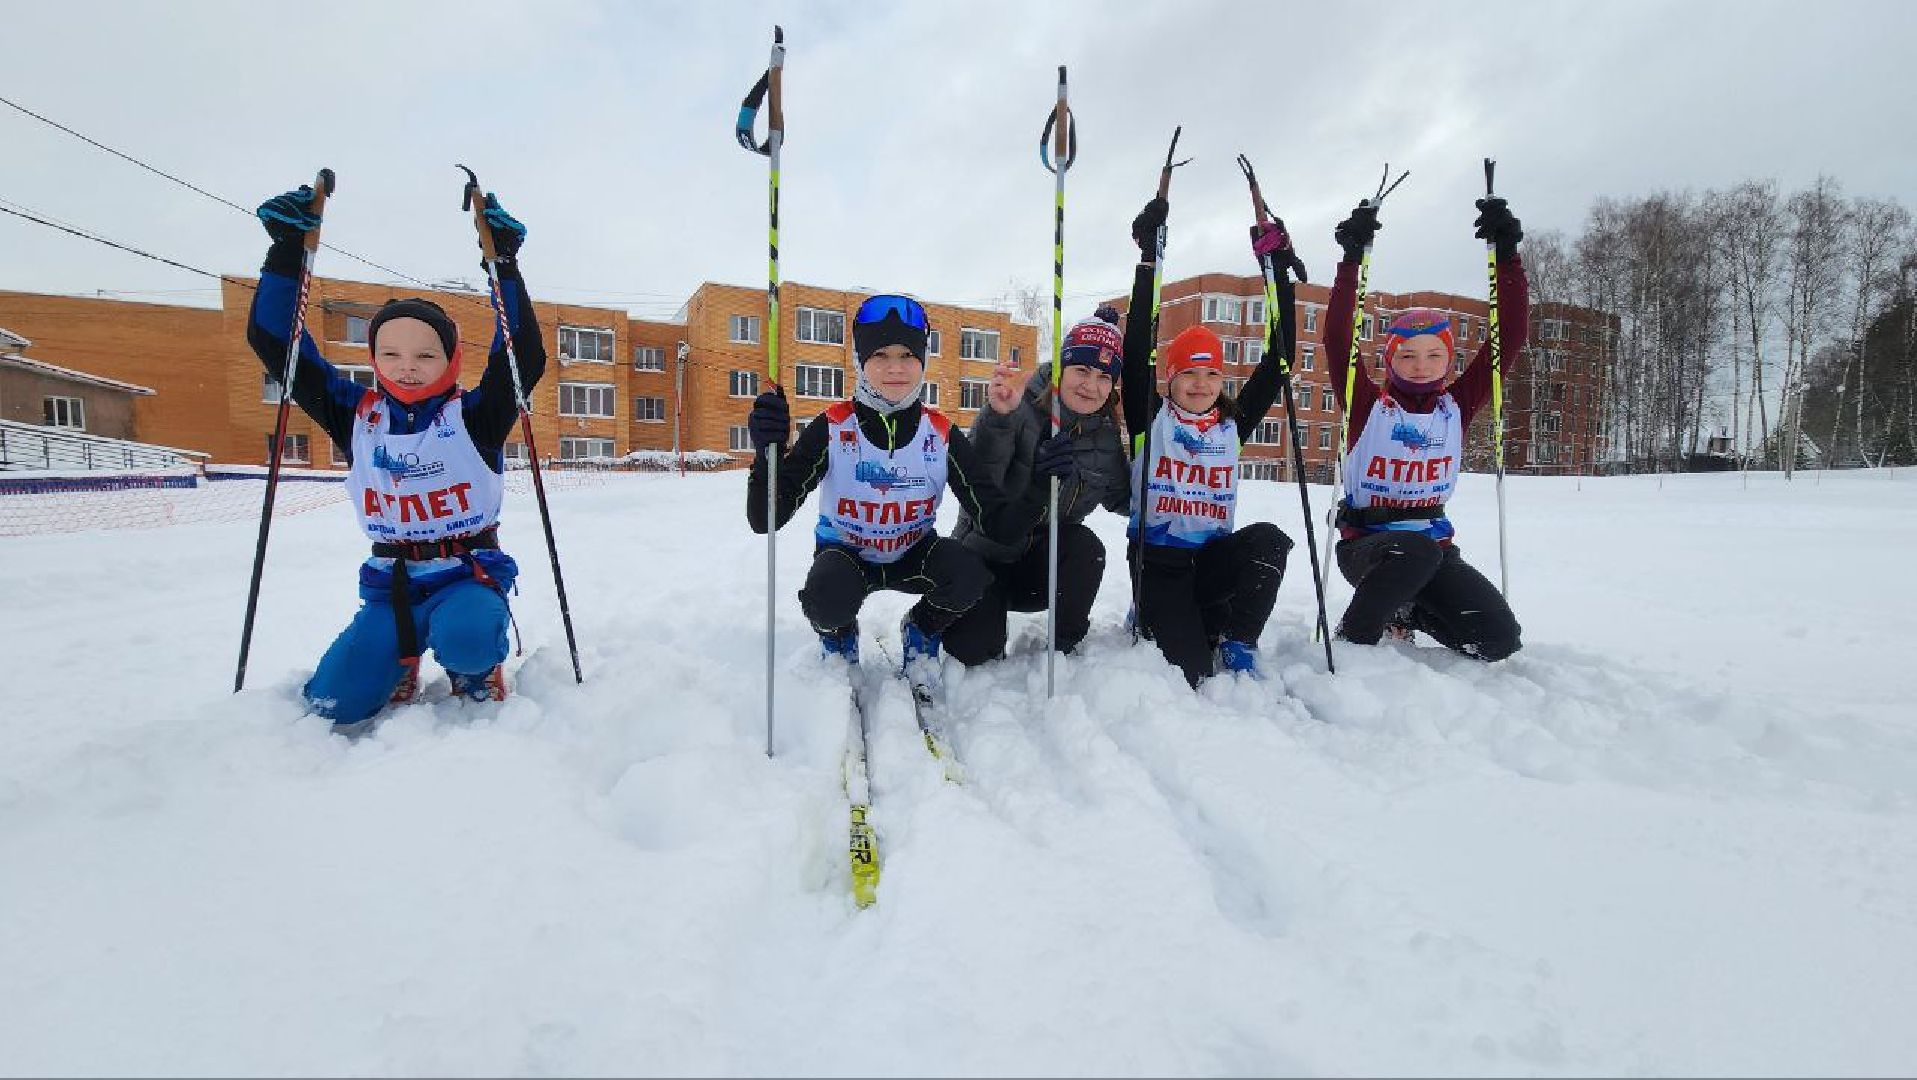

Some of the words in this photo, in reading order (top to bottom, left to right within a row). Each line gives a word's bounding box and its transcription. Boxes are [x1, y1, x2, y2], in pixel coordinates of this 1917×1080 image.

[1155, 455, 1234, 490] АТЛЕТ
[1366, 455, 1453, 483] АТЛЕТ
[365, 483, 471, 522] АТЛЕТ
[838, 495, 936, 524] АТЛЕТ
[1156, 494, 1228, 520] ДМИТРОВ
